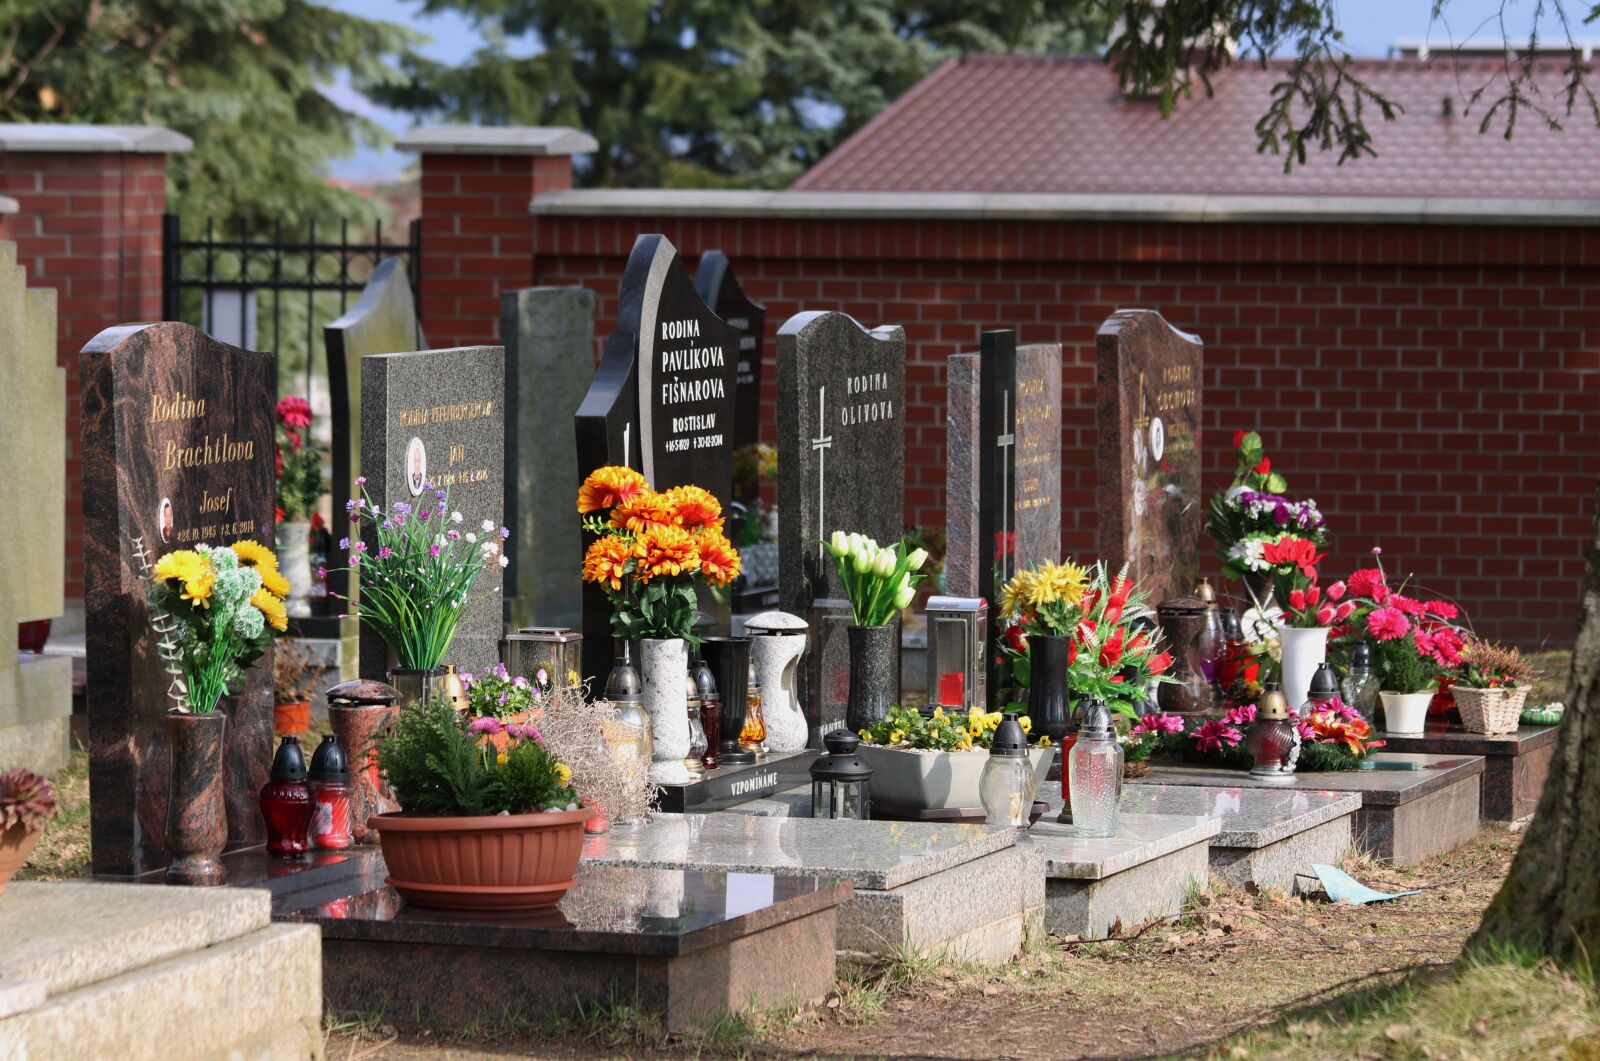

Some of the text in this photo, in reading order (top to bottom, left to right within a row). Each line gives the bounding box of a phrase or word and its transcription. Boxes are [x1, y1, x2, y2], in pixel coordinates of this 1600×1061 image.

[662, 319, 700, 340] RODINA
[662, 340, 724, 372] PAVLÍKOVA
[662, 376, 724, 404] FIŠNAROVA
[847, 372, 888, 396] RODINA
[149, 392, 206, 424] Rodina
[841, 400, 893, 427] OLIVOVA
[672, 413, 716, 434] ROSTISLAV
[164, 433, 254, 470] Brachtlova
[199, 487, 233, 516] Josef
[731, 768, 778, 797] VZPOMÍNÁME
